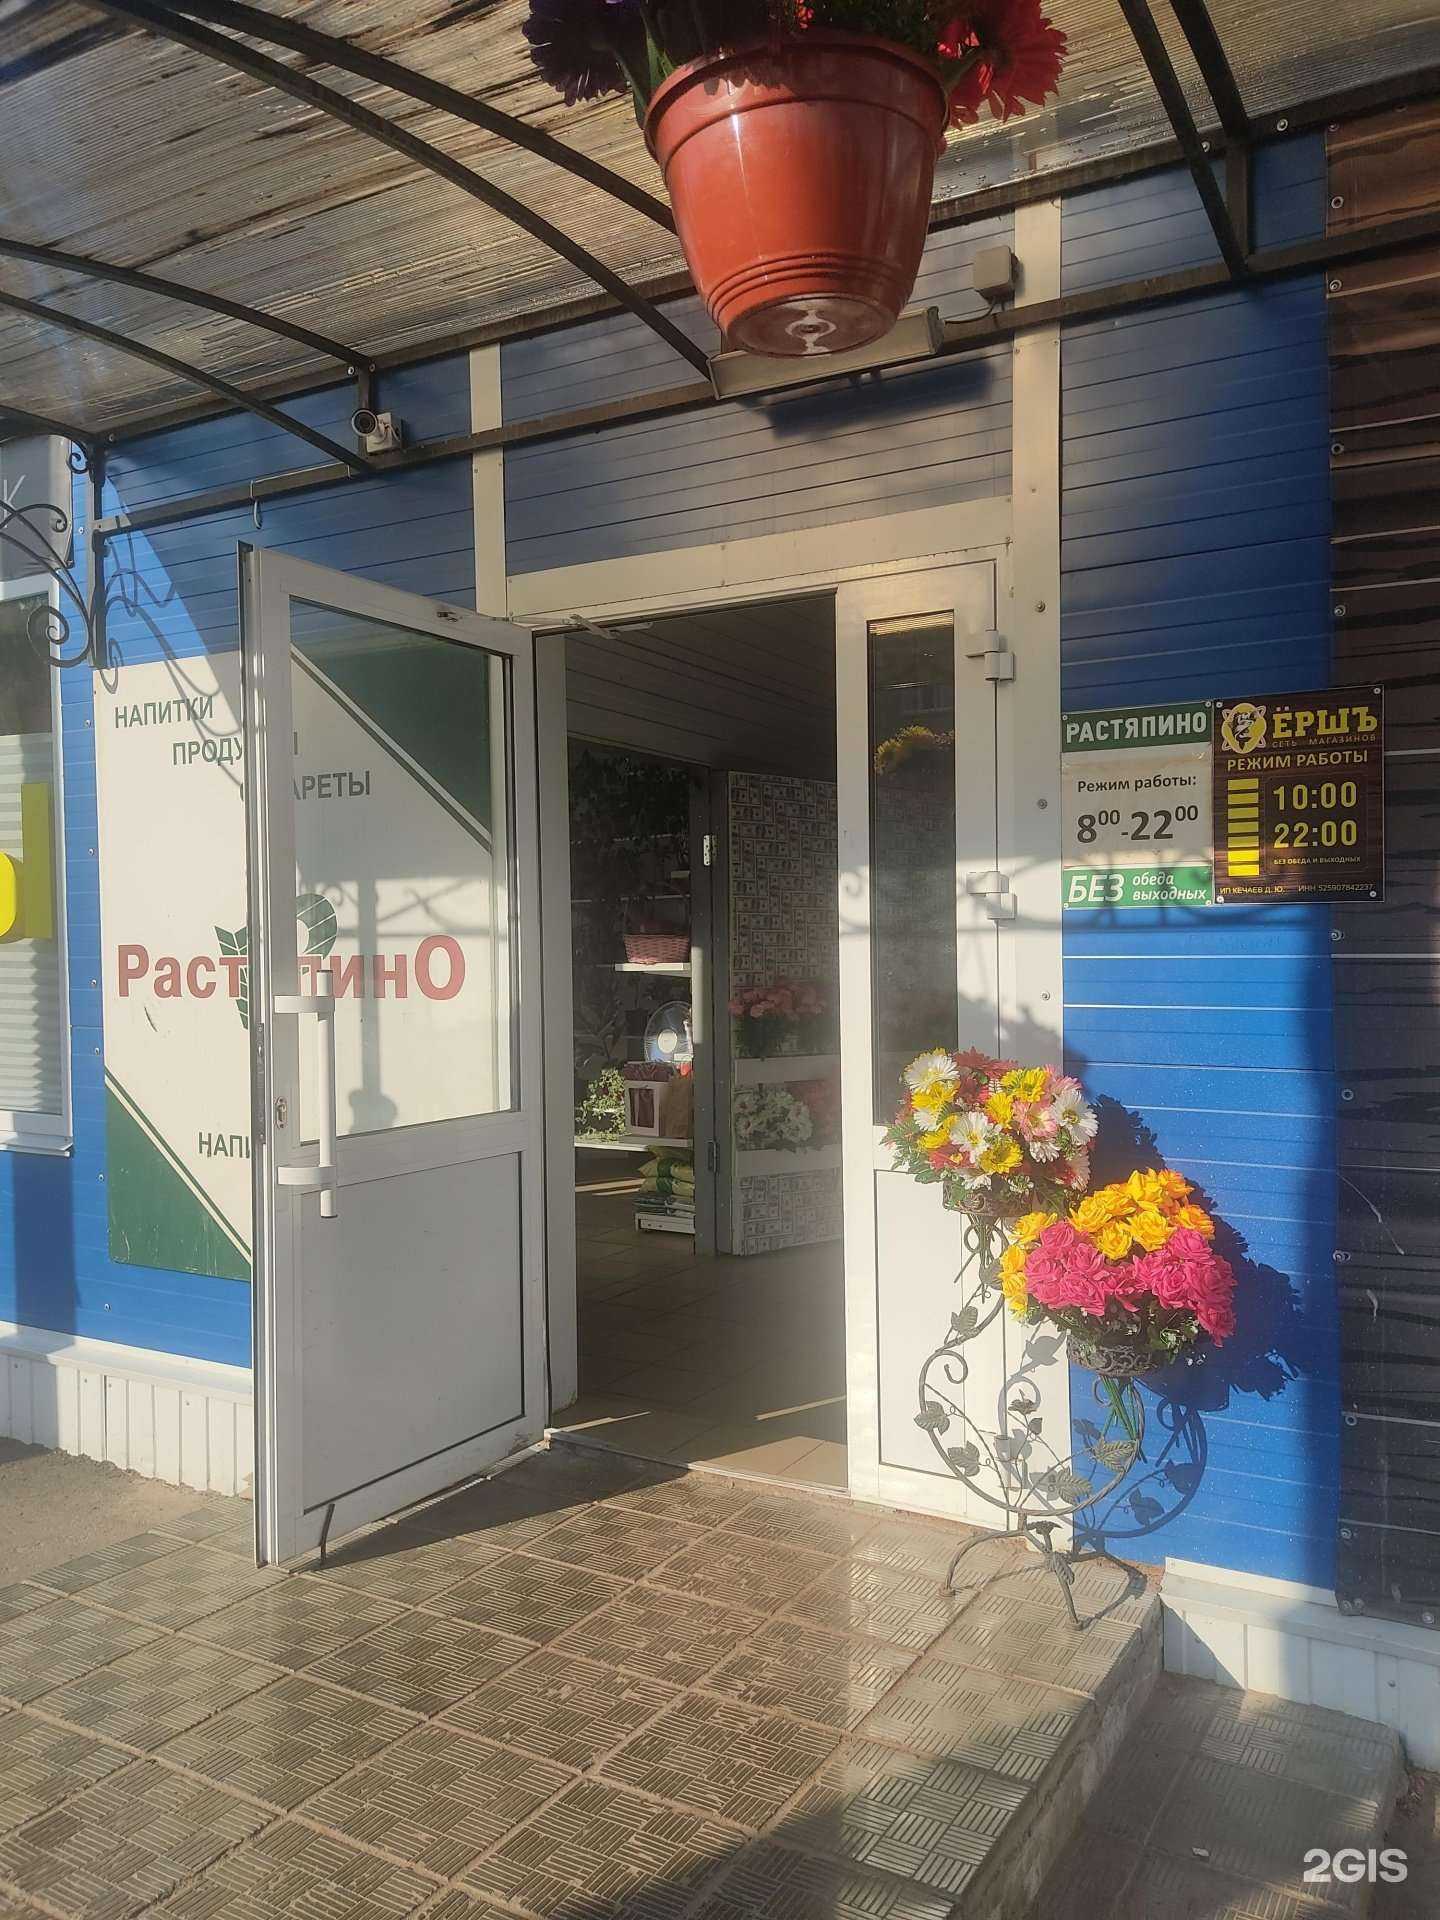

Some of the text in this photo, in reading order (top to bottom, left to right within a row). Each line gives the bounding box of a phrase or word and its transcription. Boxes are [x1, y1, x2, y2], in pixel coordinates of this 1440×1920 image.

[115, 696, 213, 728] НАПИТКИ
[1272, 706, 1378, 739] ЁРШЪ
[1066, 711, 1207, 744] РАСТЯПИНО
[1308, 734, 1376, 746] МАГАЗИНОВ
[1227, 750, 1368, 772] РЕЖИМ РАБОТЫ
[1078, 774, 1197, 793] Режим работы:
[1273, 781, 1357, 811] 10:00
[1273, 820, 1357, 849] 22:00
[1068, 873, 1125, 903] БЕЗ
[1132, 872, 1174, 886] обеда
[1132, 888, 1207, 901] выходных
[117, 934, 466, 1001] РастпинО
